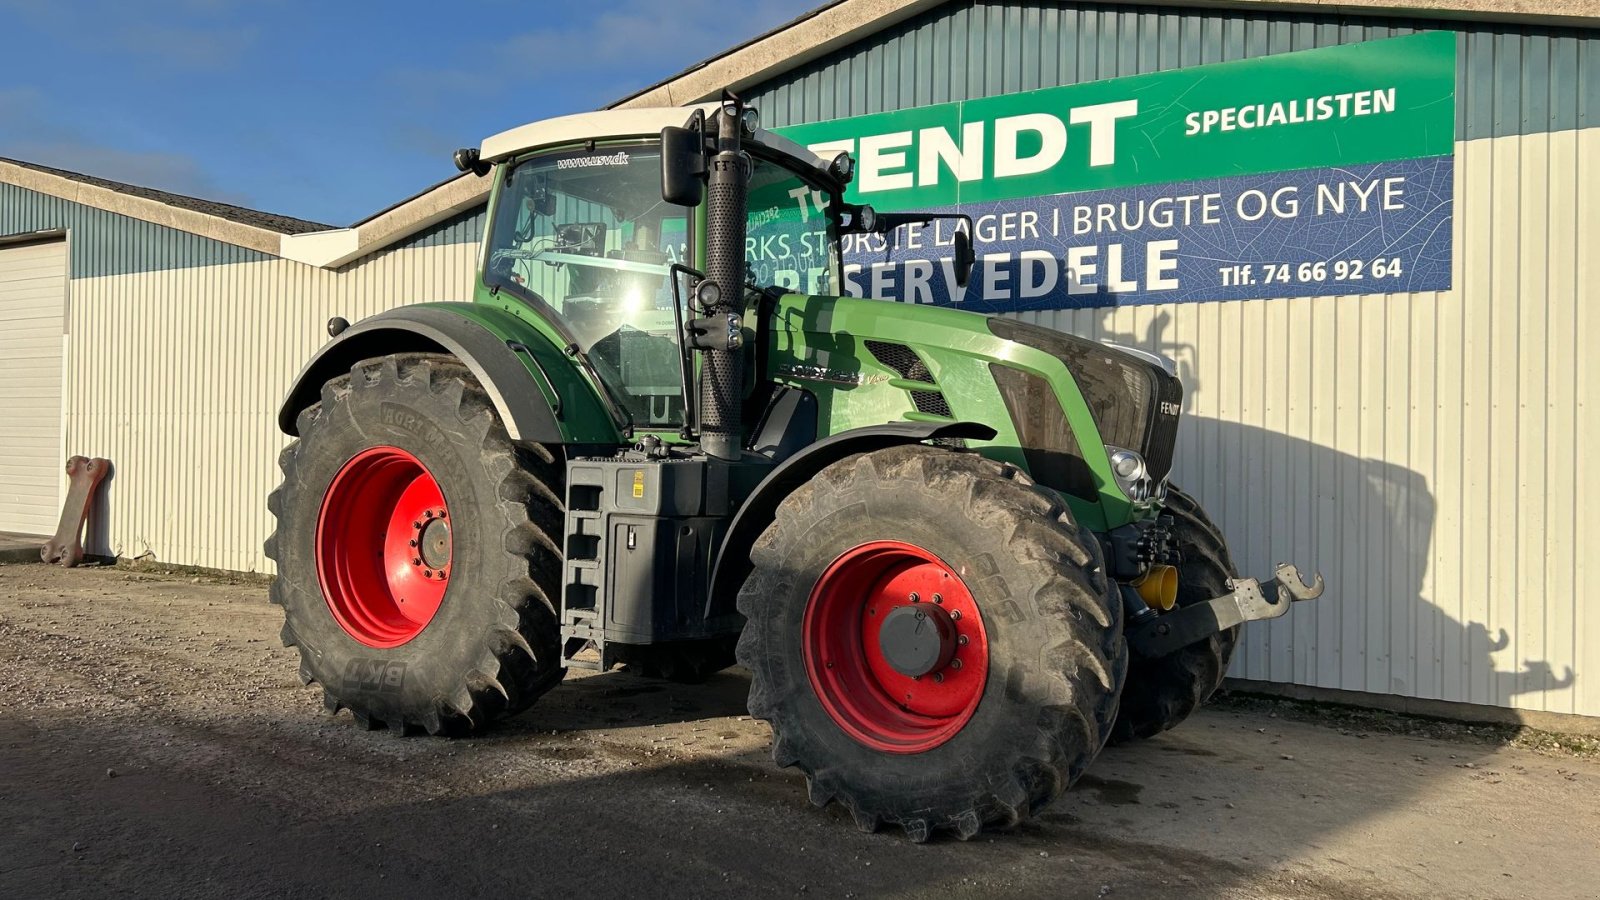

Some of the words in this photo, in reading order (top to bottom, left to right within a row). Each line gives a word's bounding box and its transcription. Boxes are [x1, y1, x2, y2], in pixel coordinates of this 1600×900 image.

[1185, 87, 1396, 136] SPECIALISTEN
[557, 151, 630, 169] www.usv.dk
[934, 210, 1040, 247] LAGER
[1052, 208, 1059, 237] I
[1073, 193, 1221, 235] BRUGTE
[1236, 186, 1299, 221] OG
[1316, 177, 1405, 216] NYE
[1219, 264, 1256, 287] Tlf.
[1262, 263, 1291, 284] 74
[1297, 262, 1327, 282] 66
[1334, 259, 1363, 281] 92
[1371, 257, 1402, 279] 64
[1160, 401, 1181, 416] FENDT
